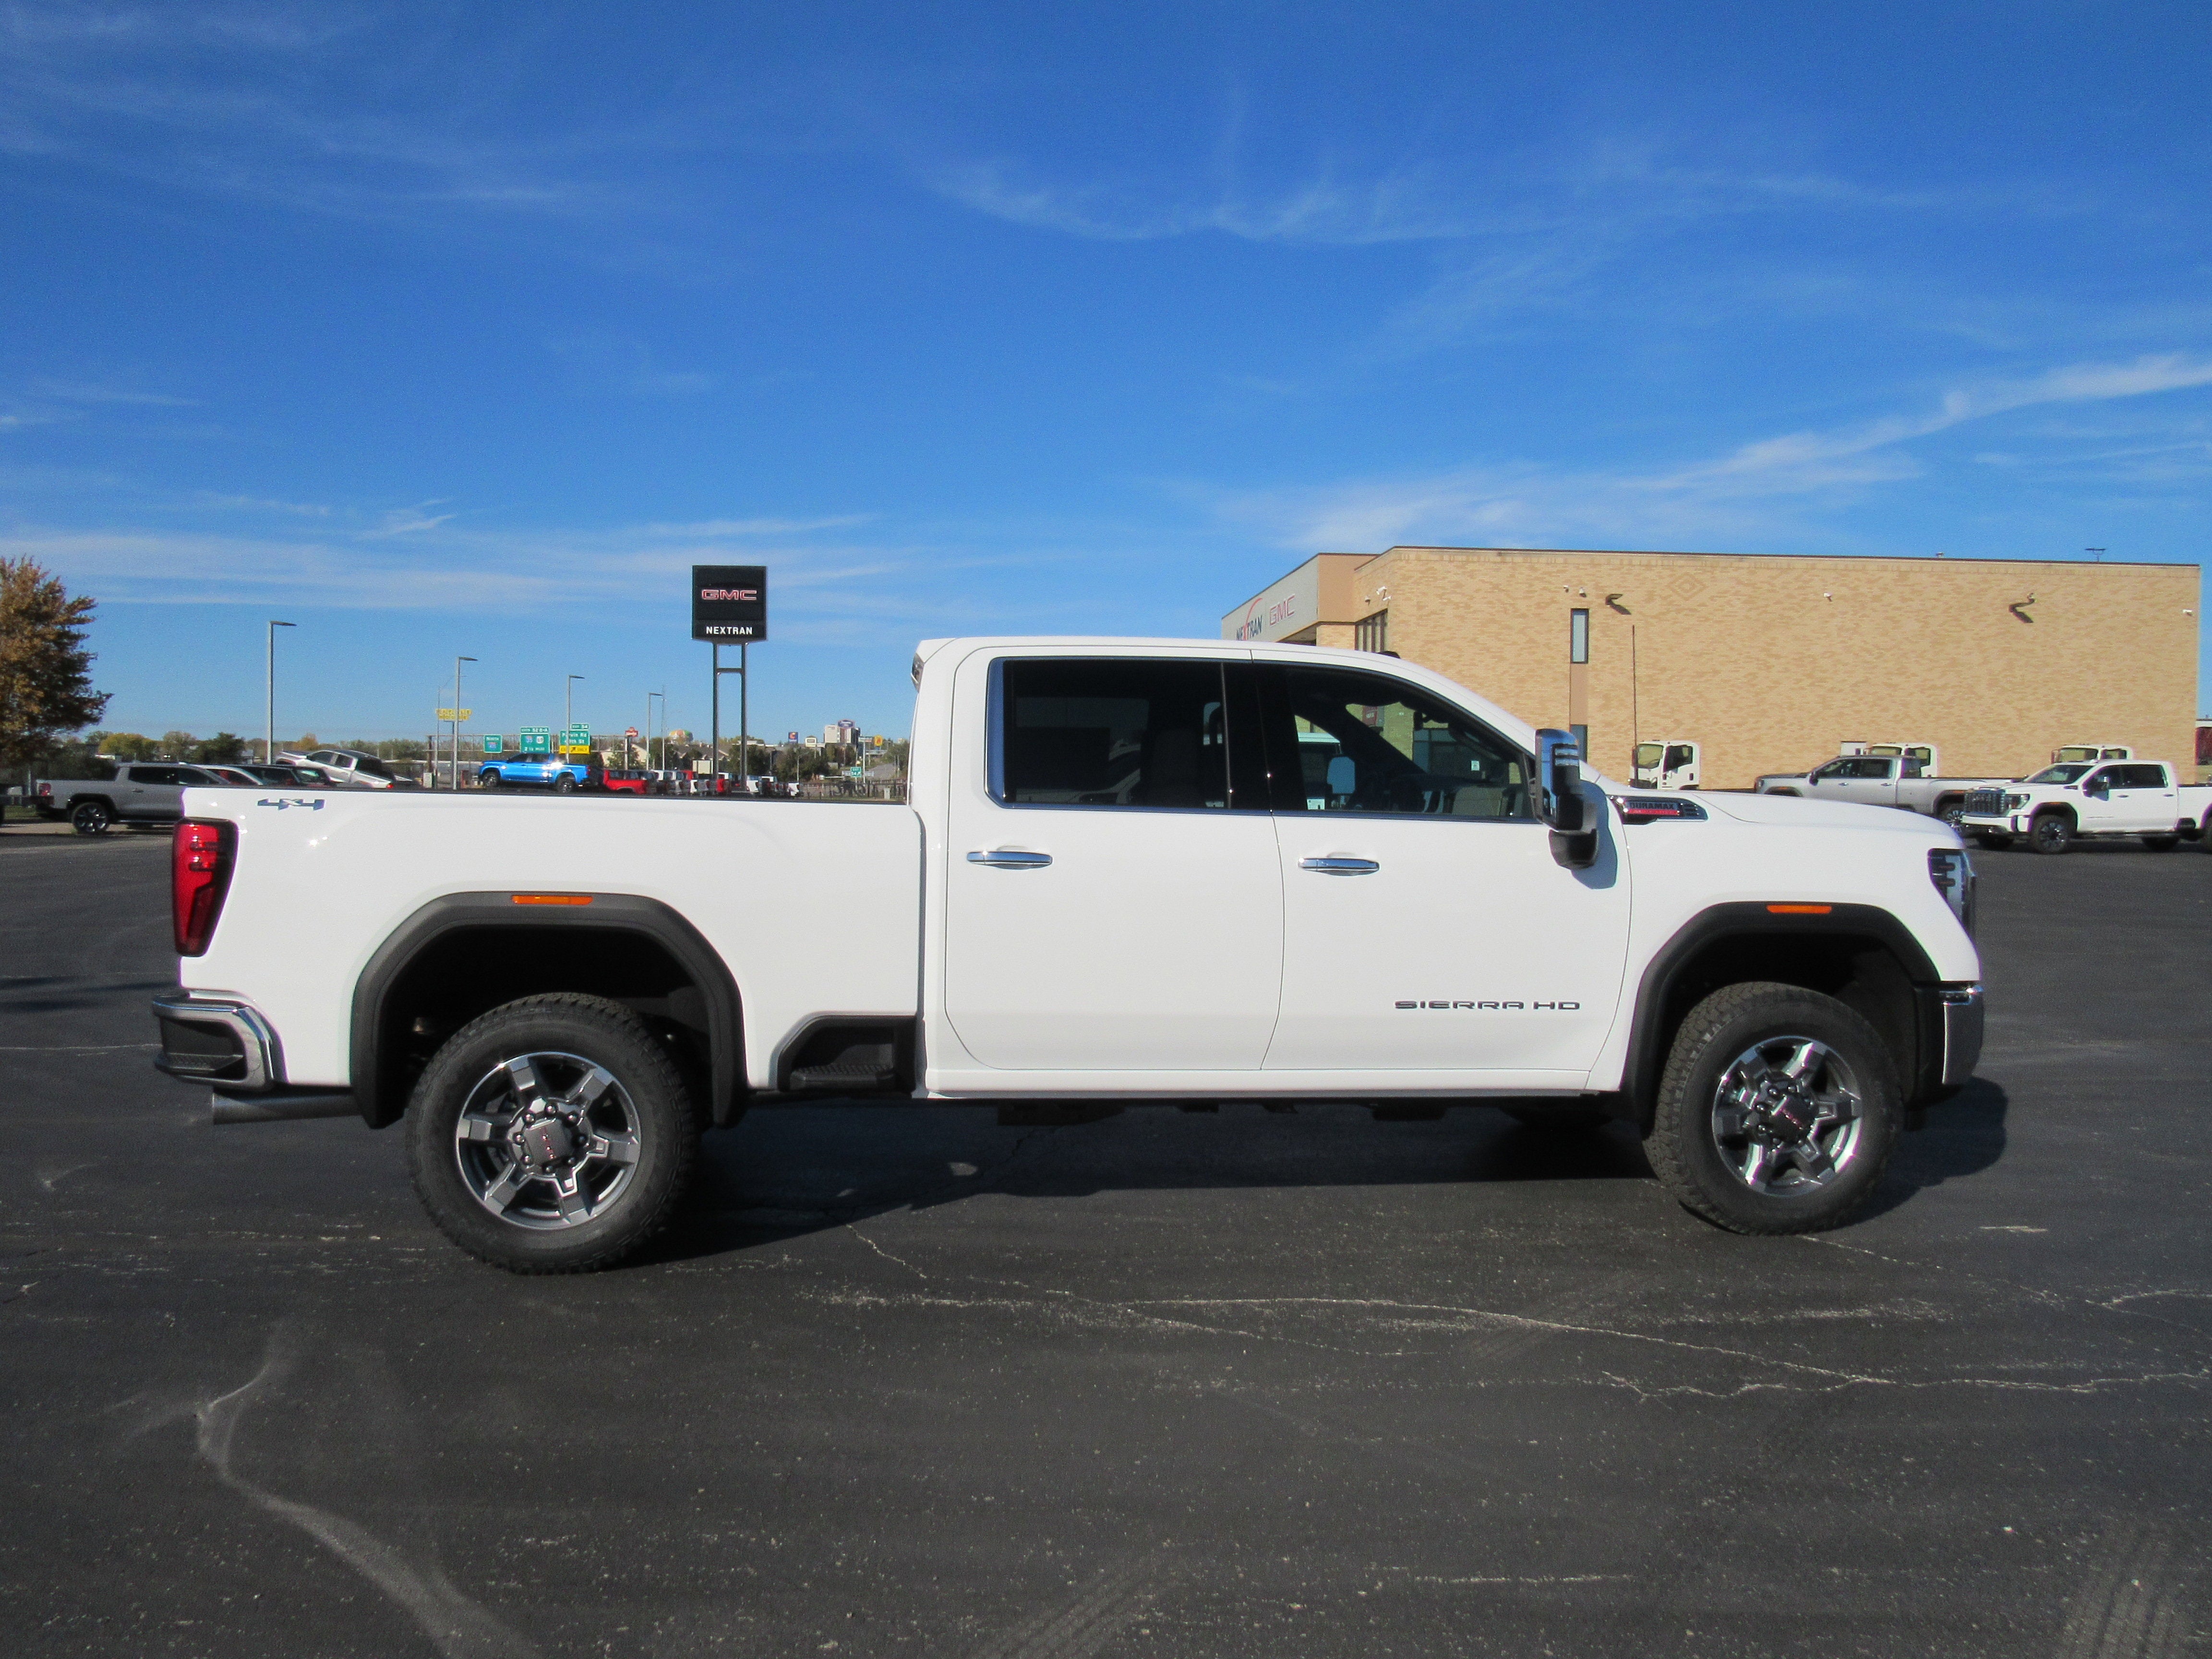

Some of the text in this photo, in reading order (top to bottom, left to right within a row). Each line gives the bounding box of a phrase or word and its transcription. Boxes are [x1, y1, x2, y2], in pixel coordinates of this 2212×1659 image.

[702, 589, 757, 600] GMC
[1269, 594, 1295, 626] GMC
[706, 626, 753, 635] NEXTRAN
[1394, 1001, 1580, 1010] SIERRA HD
